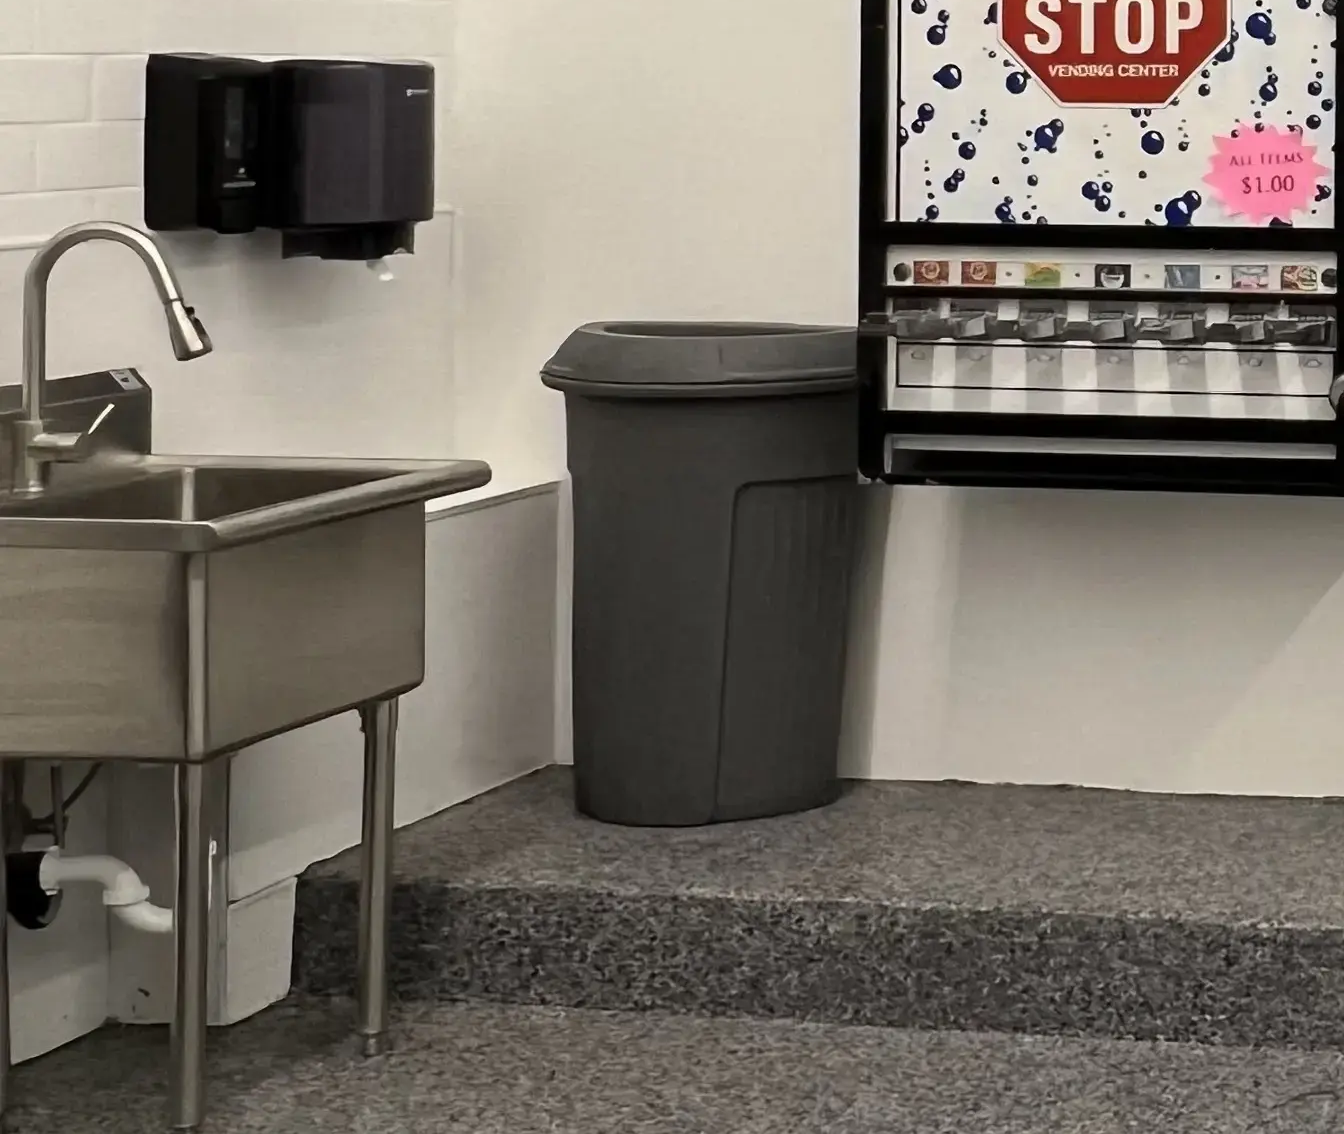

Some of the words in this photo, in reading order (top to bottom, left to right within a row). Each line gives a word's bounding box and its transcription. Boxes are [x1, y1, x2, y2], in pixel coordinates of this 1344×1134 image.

[1048, 64, 1114, 77] VENDING
[1117, 64, 1179, 78] CENTER
[1241, 174, 1295, 195] $1.00
